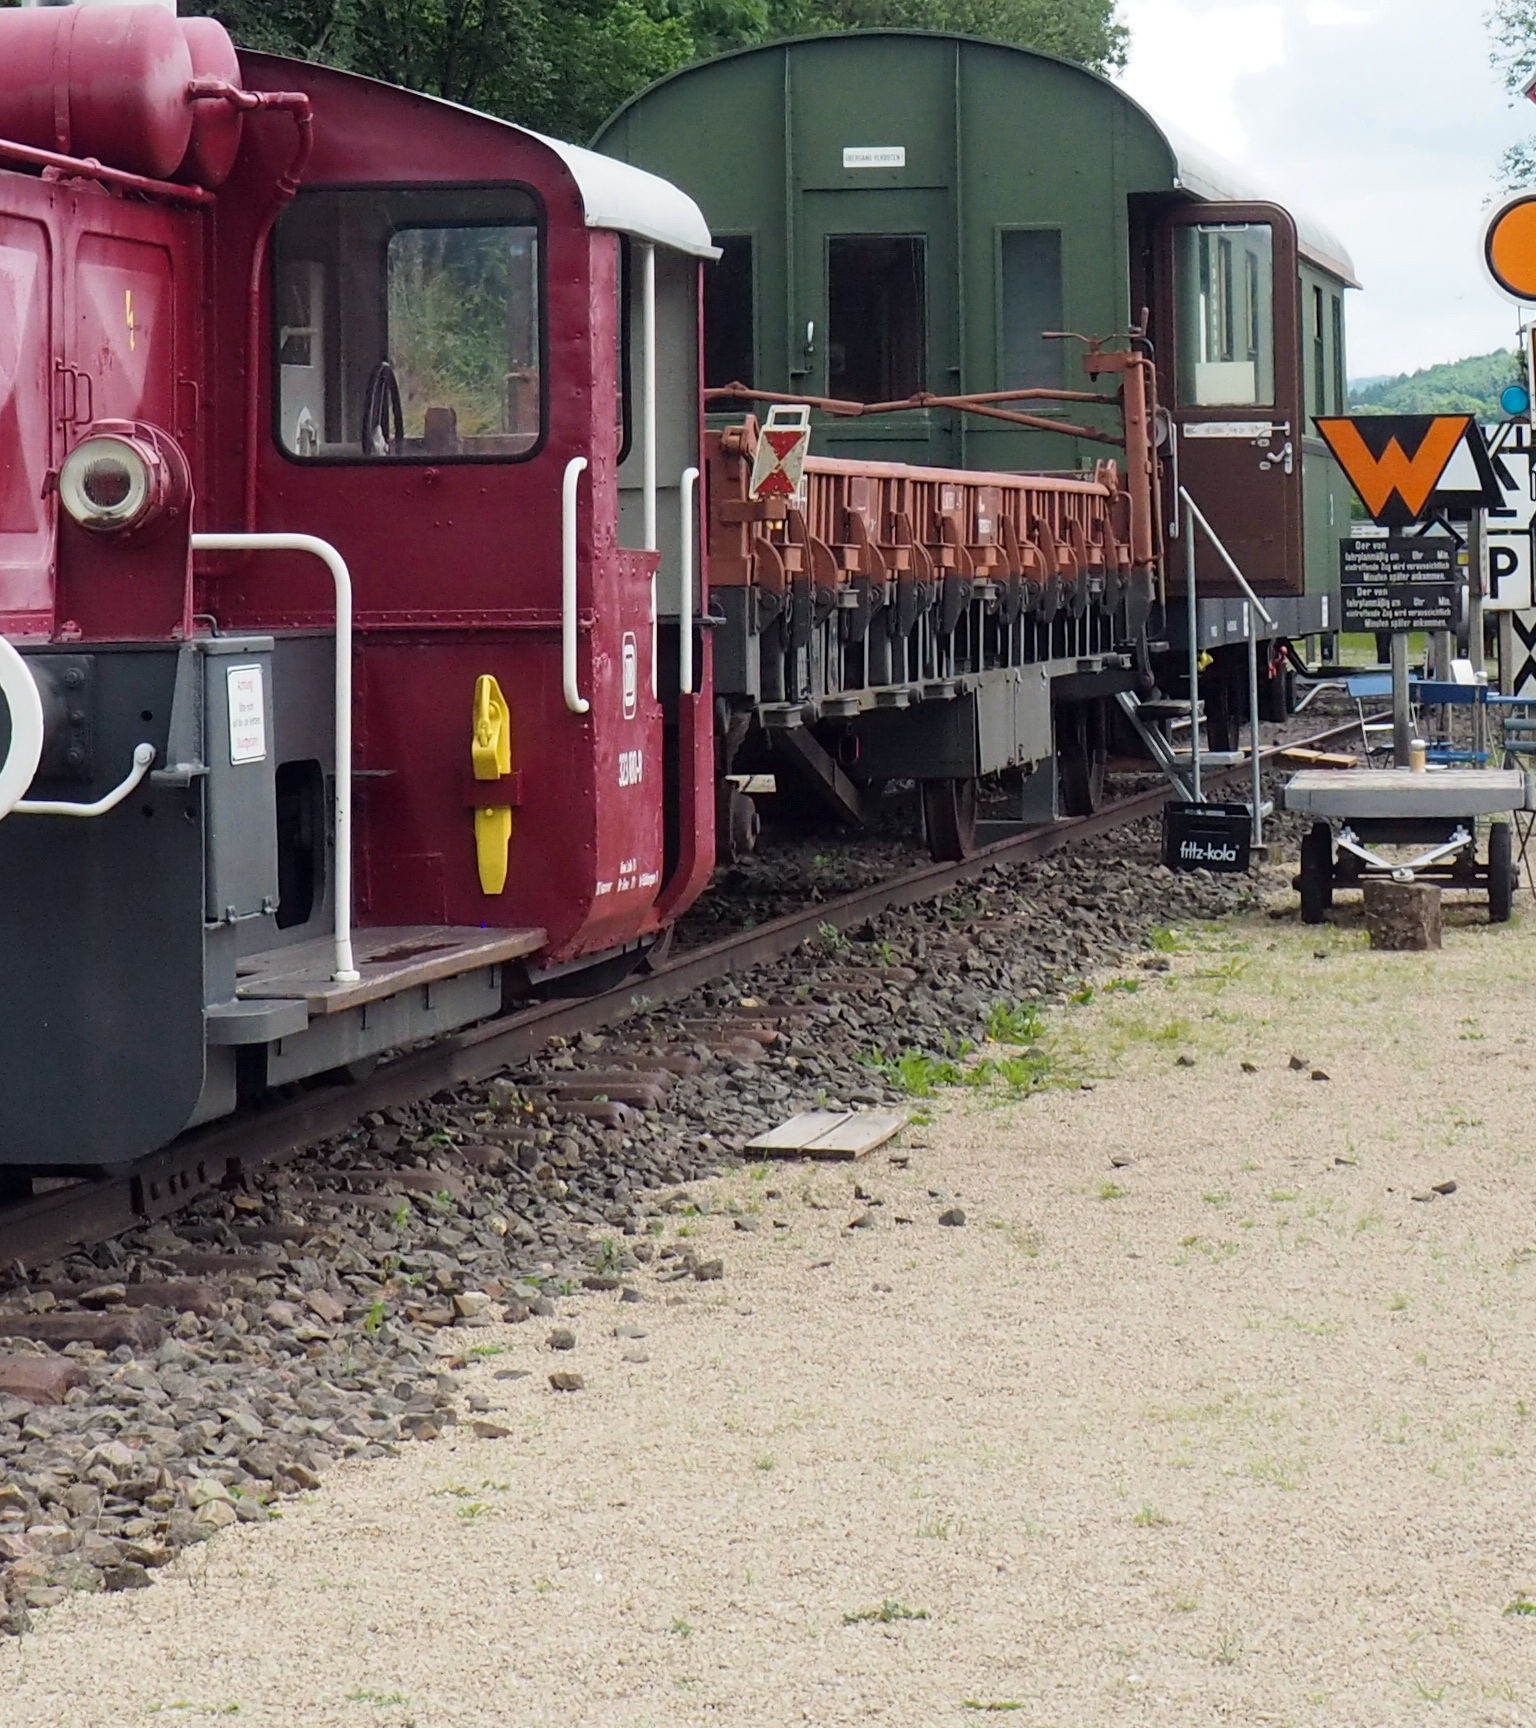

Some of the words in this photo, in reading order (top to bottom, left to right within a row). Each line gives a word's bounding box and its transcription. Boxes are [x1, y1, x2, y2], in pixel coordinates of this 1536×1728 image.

[1355, 540, 1371, 550] Der
[1372, 541, 1387, 550] von
[1489, 546, 1519, 599] P
[1356, 586, 1372, 597] Der
[1374, 588, 1388, 596] von
[1179, 840, 1237, 862] fritz-kola
